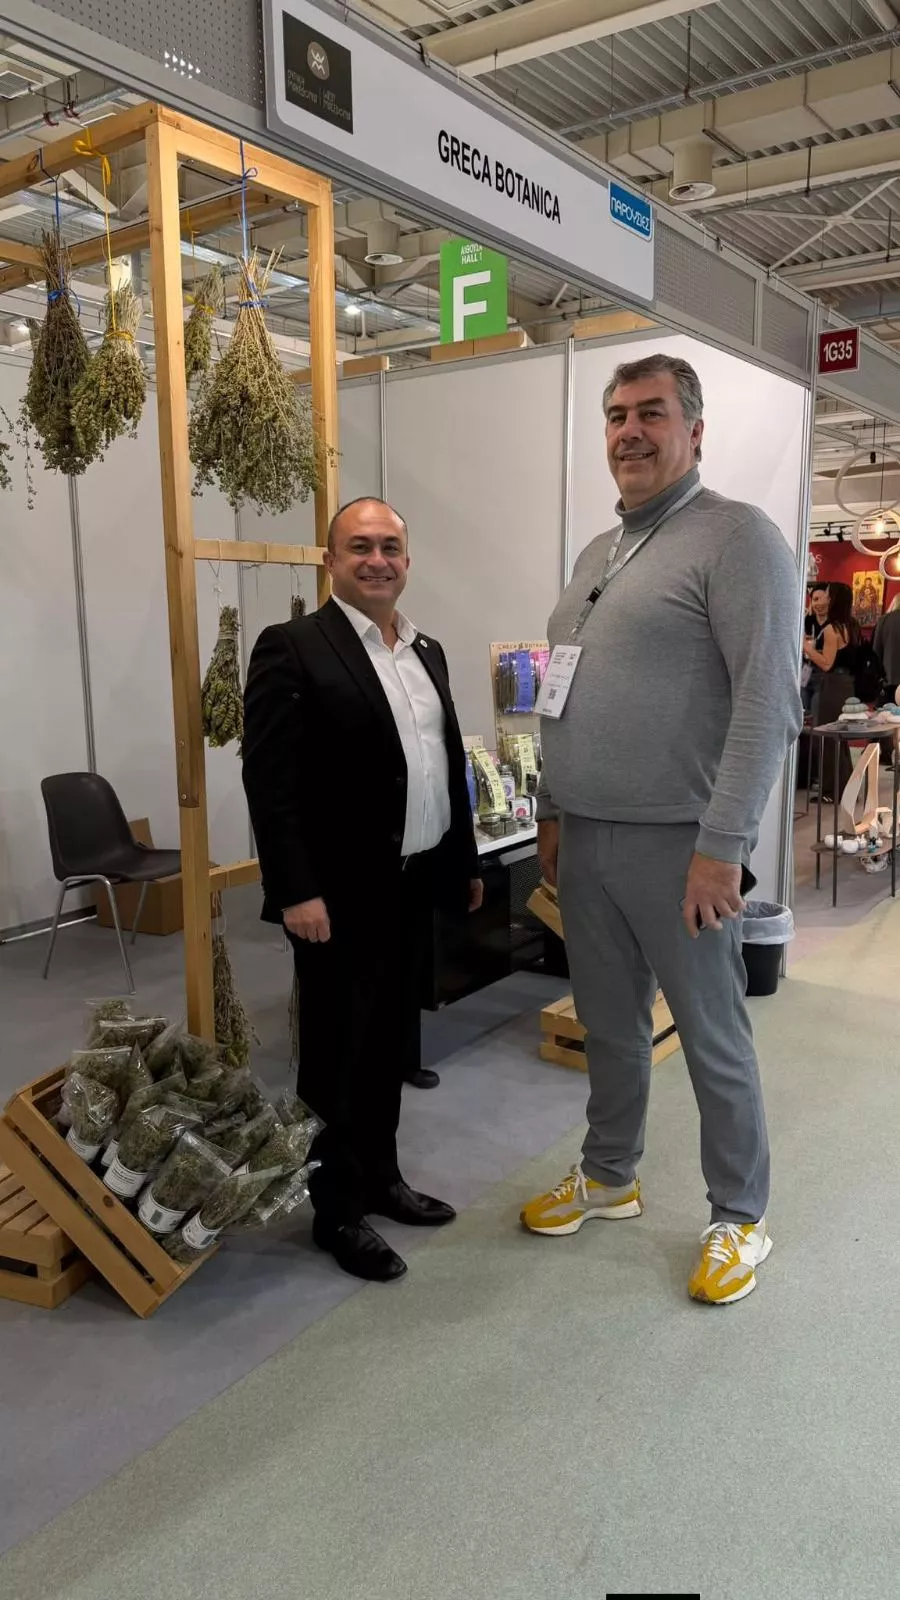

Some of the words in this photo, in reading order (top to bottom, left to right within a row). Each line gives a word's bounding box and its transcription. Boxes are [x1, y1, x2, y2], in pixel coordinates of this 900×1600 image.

[438, 130, 492, 187] GRECA
[495, 161, 561, 224] BOTANICA
[611, 196, 650, 231] ΠΑΡΟΥΣΙΕΣ
[461, 253, 478, 265] HALL
[453, 270, 491, 342] F
[823, 340, 853, 362] 1G35
